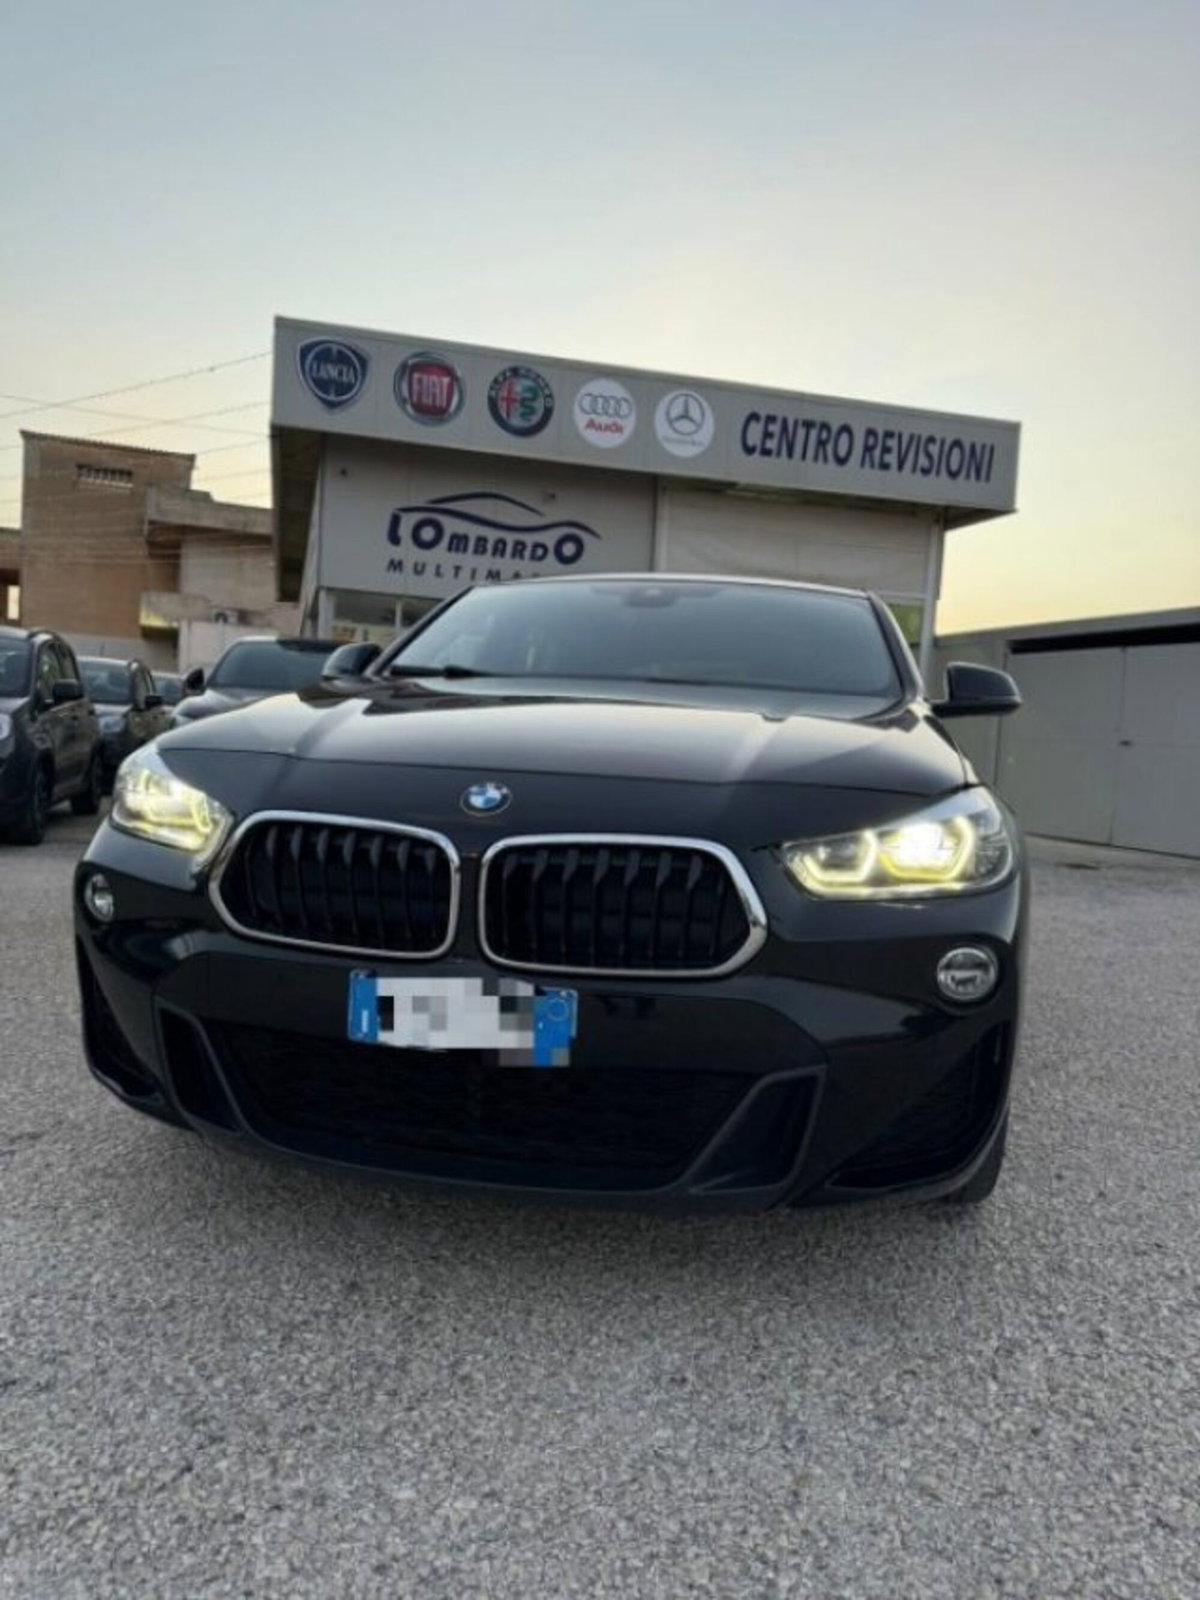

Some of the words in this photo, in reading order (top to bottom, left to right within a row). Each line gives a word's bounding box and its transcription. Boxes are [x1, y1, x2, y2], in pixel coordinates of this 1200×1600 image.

[311, 361, 356, 385] LANCIA
[412, 372, 451, 408] FIAT
[585, 417, 624, 435] Audi
[740, 411, 855, 467] CENTRO
[859, 426, 995, 483] REVISIONI
